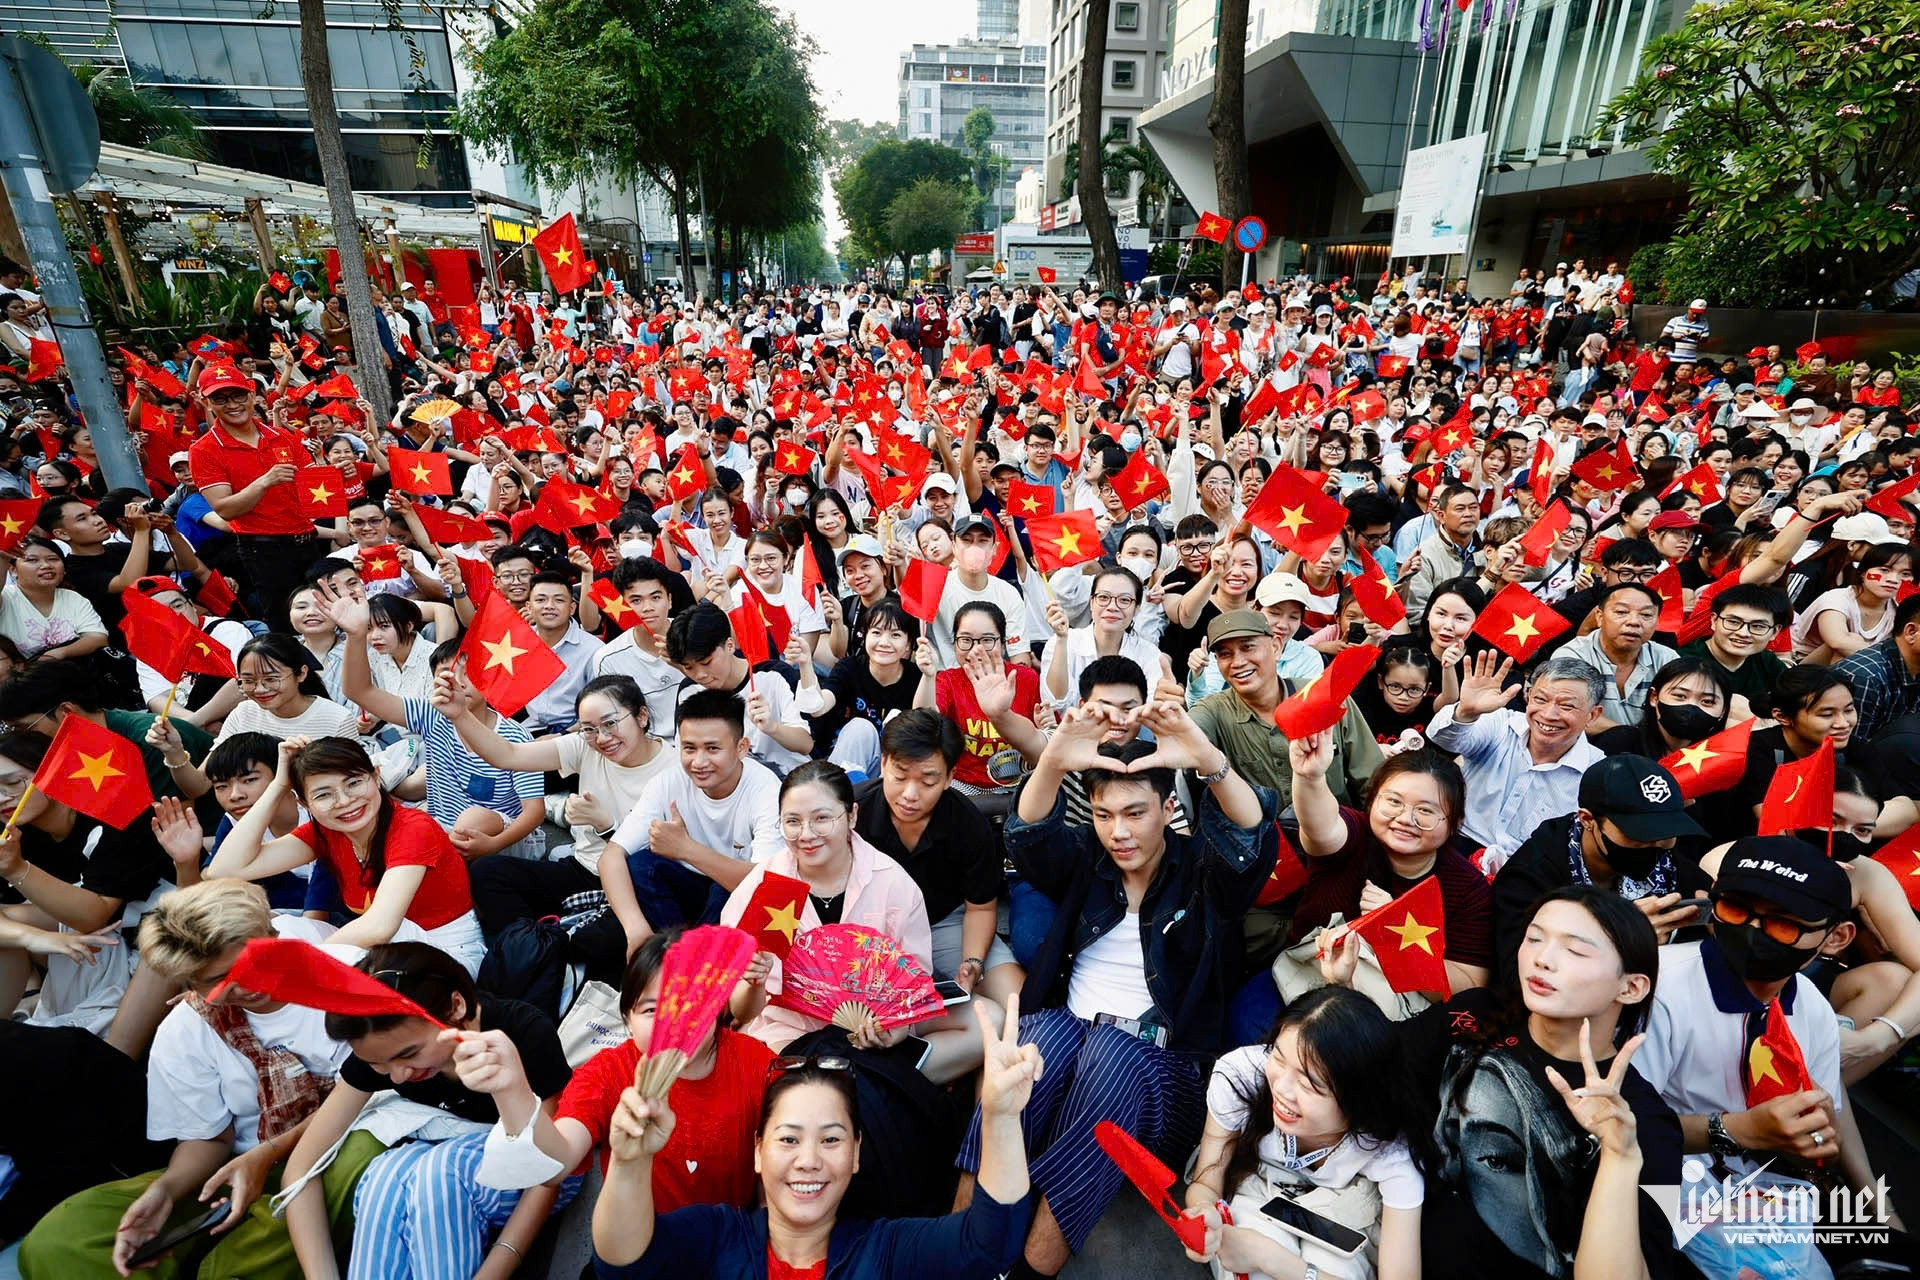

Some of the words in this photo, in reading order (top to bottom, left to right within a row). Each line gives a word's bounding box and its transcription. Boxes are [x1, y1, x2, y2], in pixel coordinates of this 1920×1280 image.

[1160, 8, 1270, 101] NOVOEL
[176, 260, 205, 269] WNZ
[1014, 250, 1036, 260] IDC
[966, 718, 1001, 738] VIE
[1737, 858, 1760, 869] The
[1760, 859, 1809, 883] Weird
